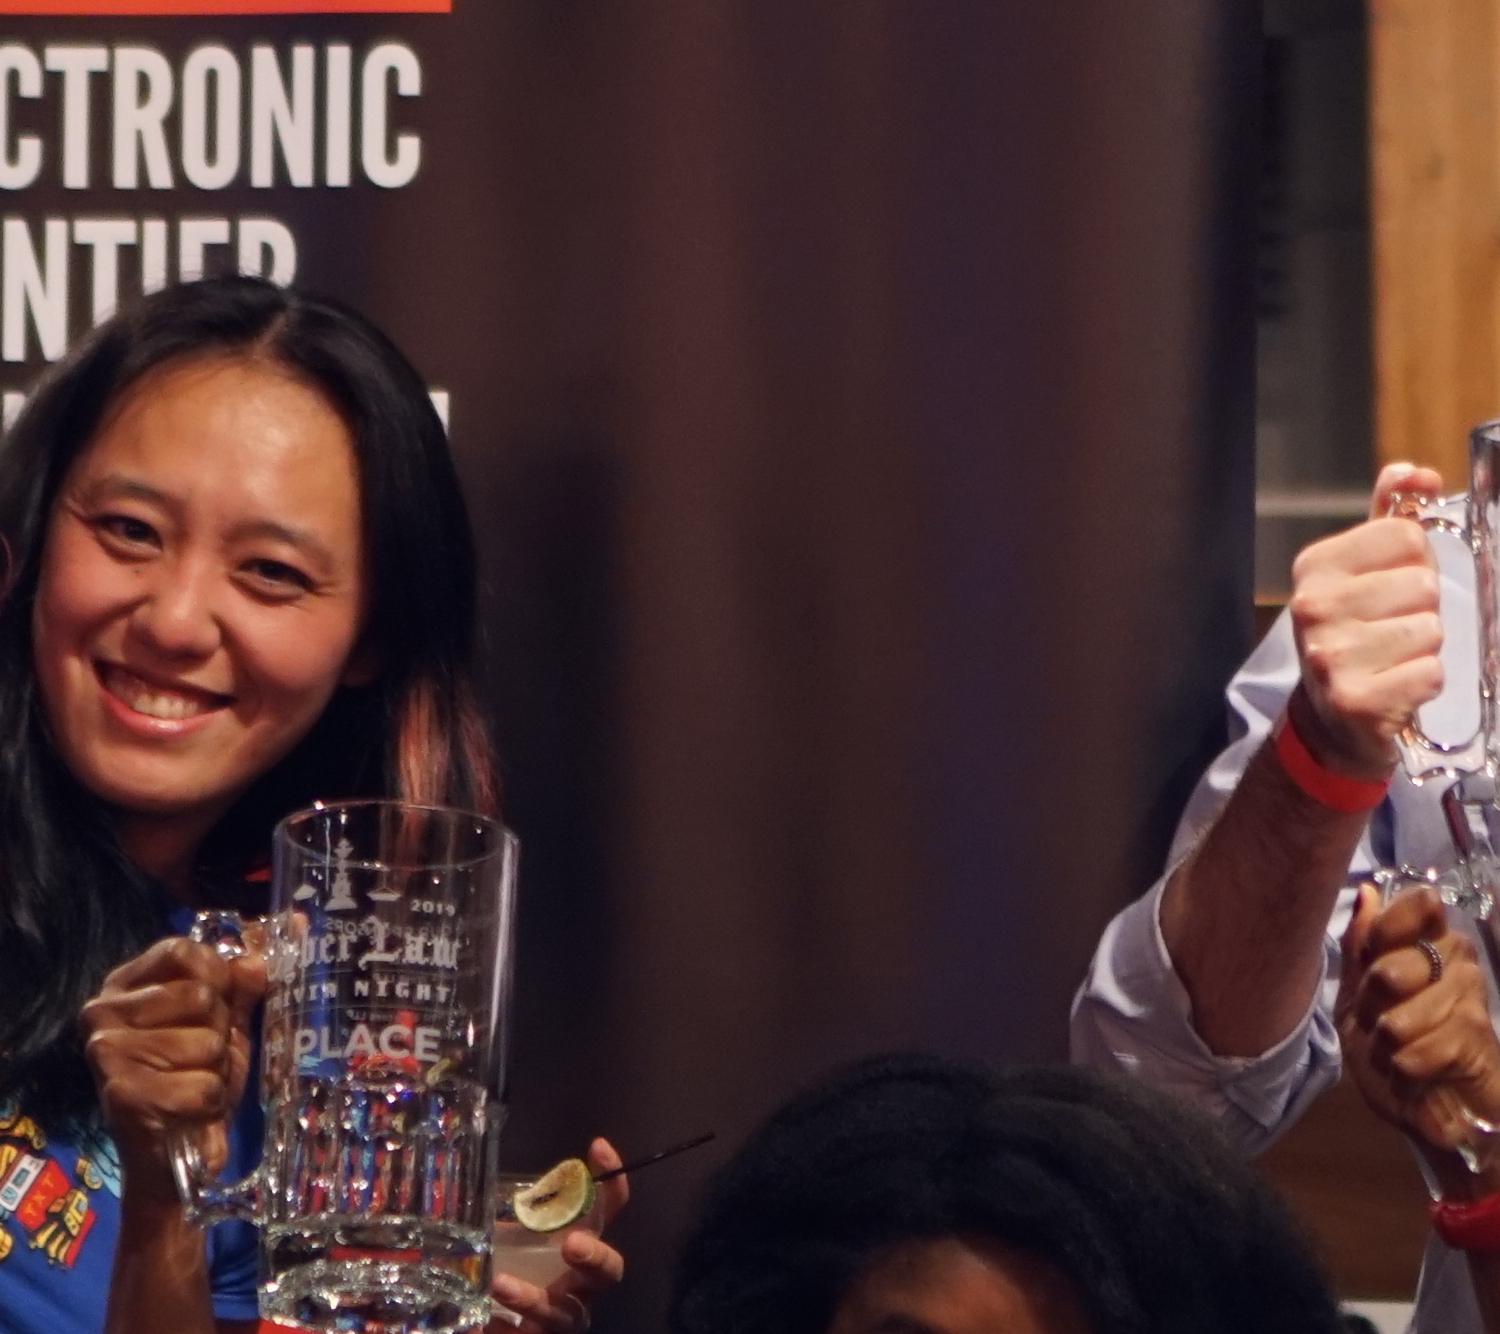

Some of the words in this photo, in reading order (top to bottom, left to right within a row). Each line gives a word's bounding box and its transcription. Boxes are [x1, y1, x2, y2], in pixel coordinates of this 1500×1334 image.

[411, 898, 456, 916] 2019
[354, 979, 450, 1004] NIGHT
[295, 1023, 442, 1063] PLACE
